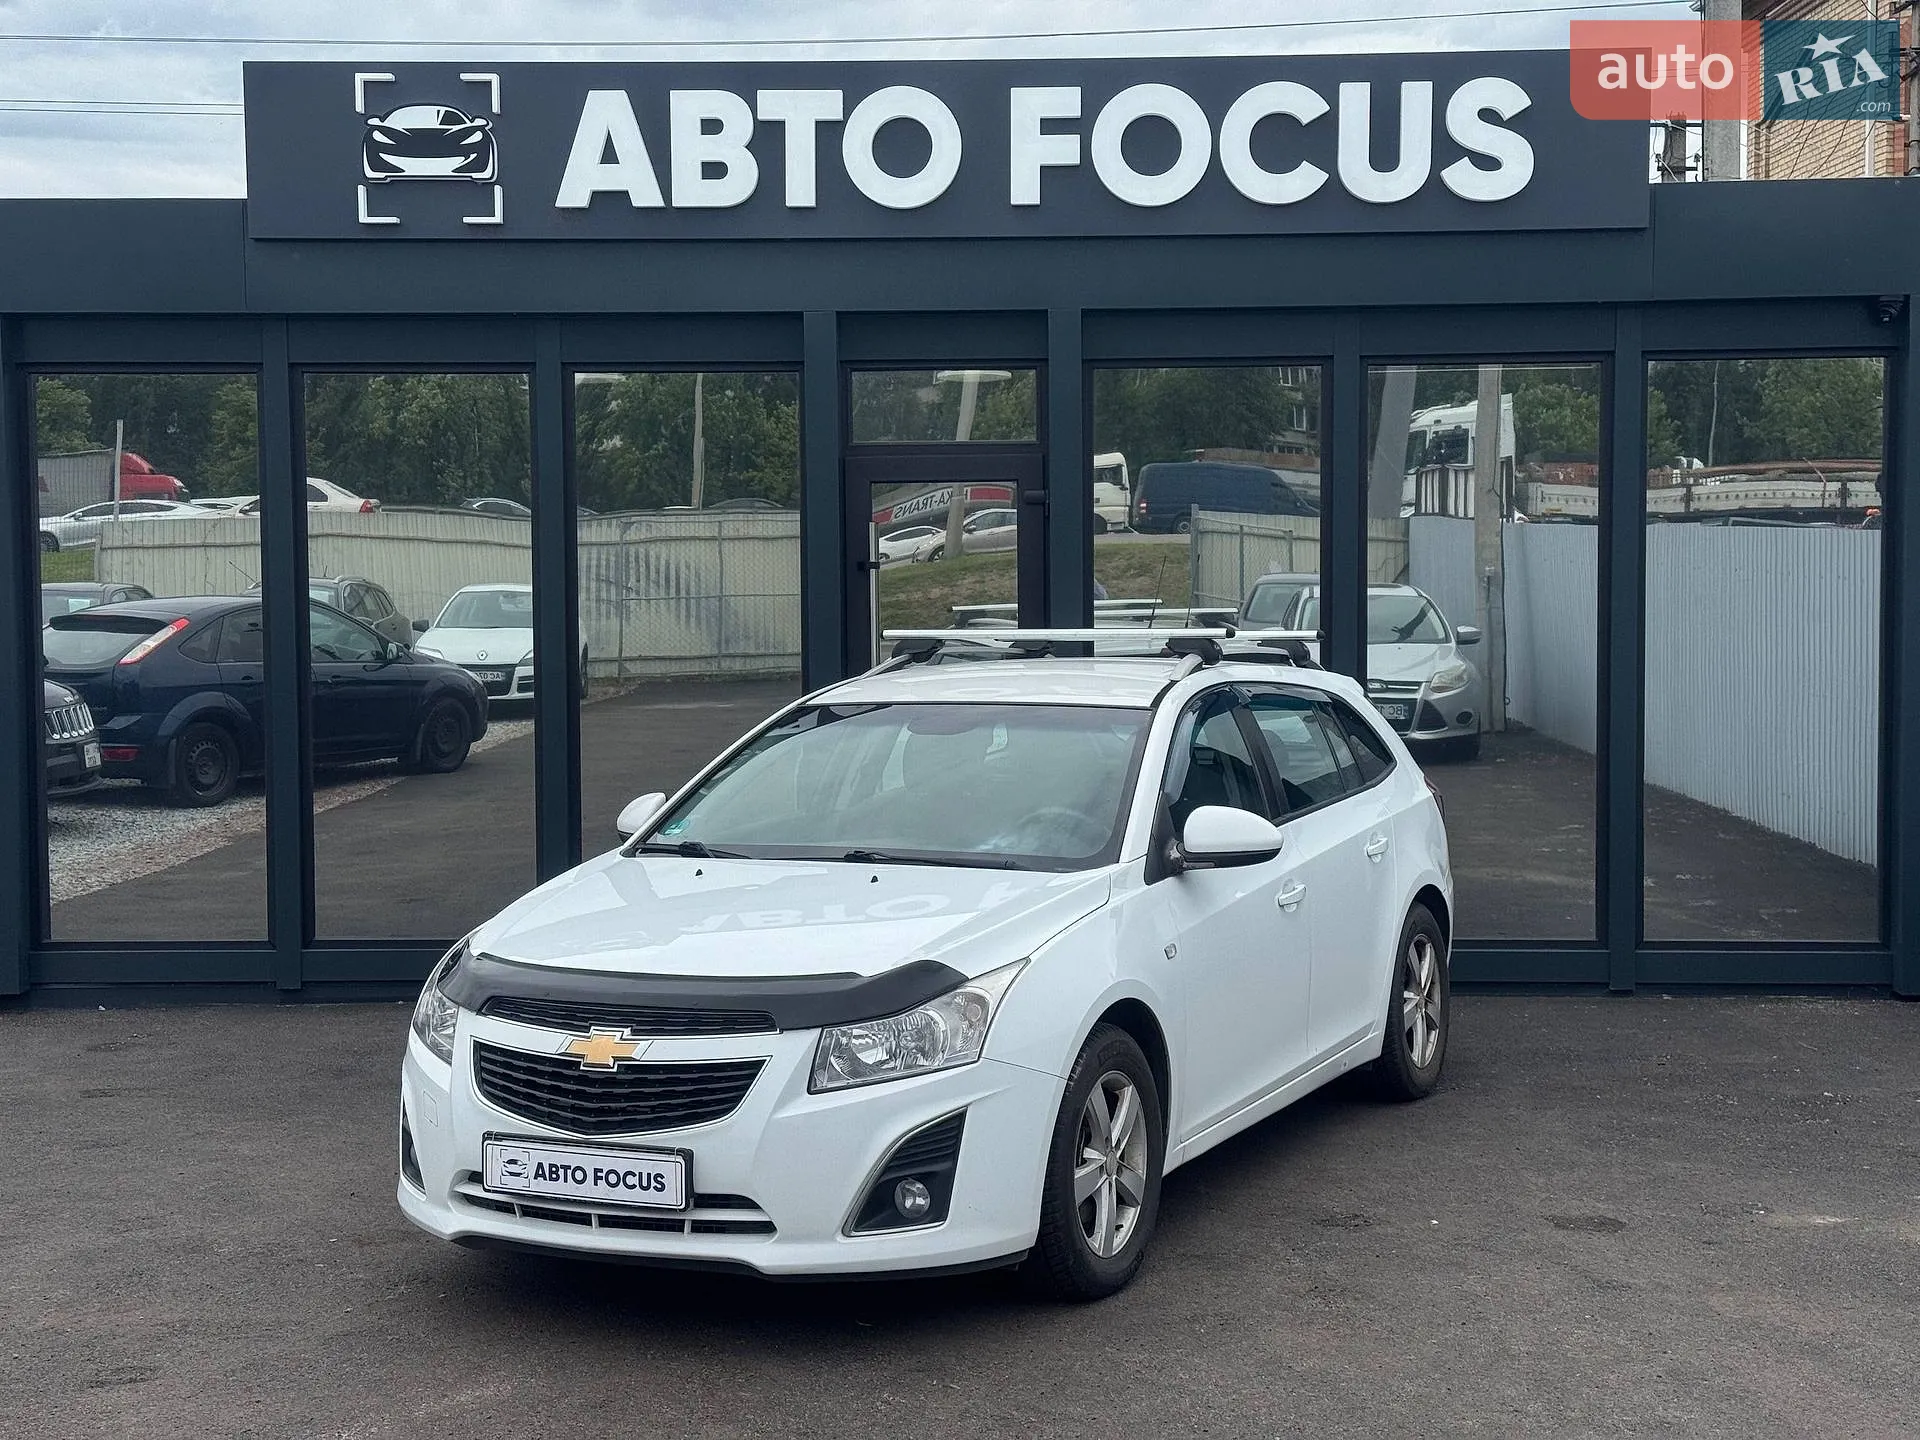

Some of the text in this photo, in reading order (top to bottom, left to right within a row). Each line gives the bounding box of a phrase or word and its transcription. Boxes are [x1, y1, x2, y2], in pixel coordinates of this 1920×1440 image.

[555, 77, 1534, 208] АВТО FOCUS
[533, 1162, 666, 1193] АВТО FOCUS
